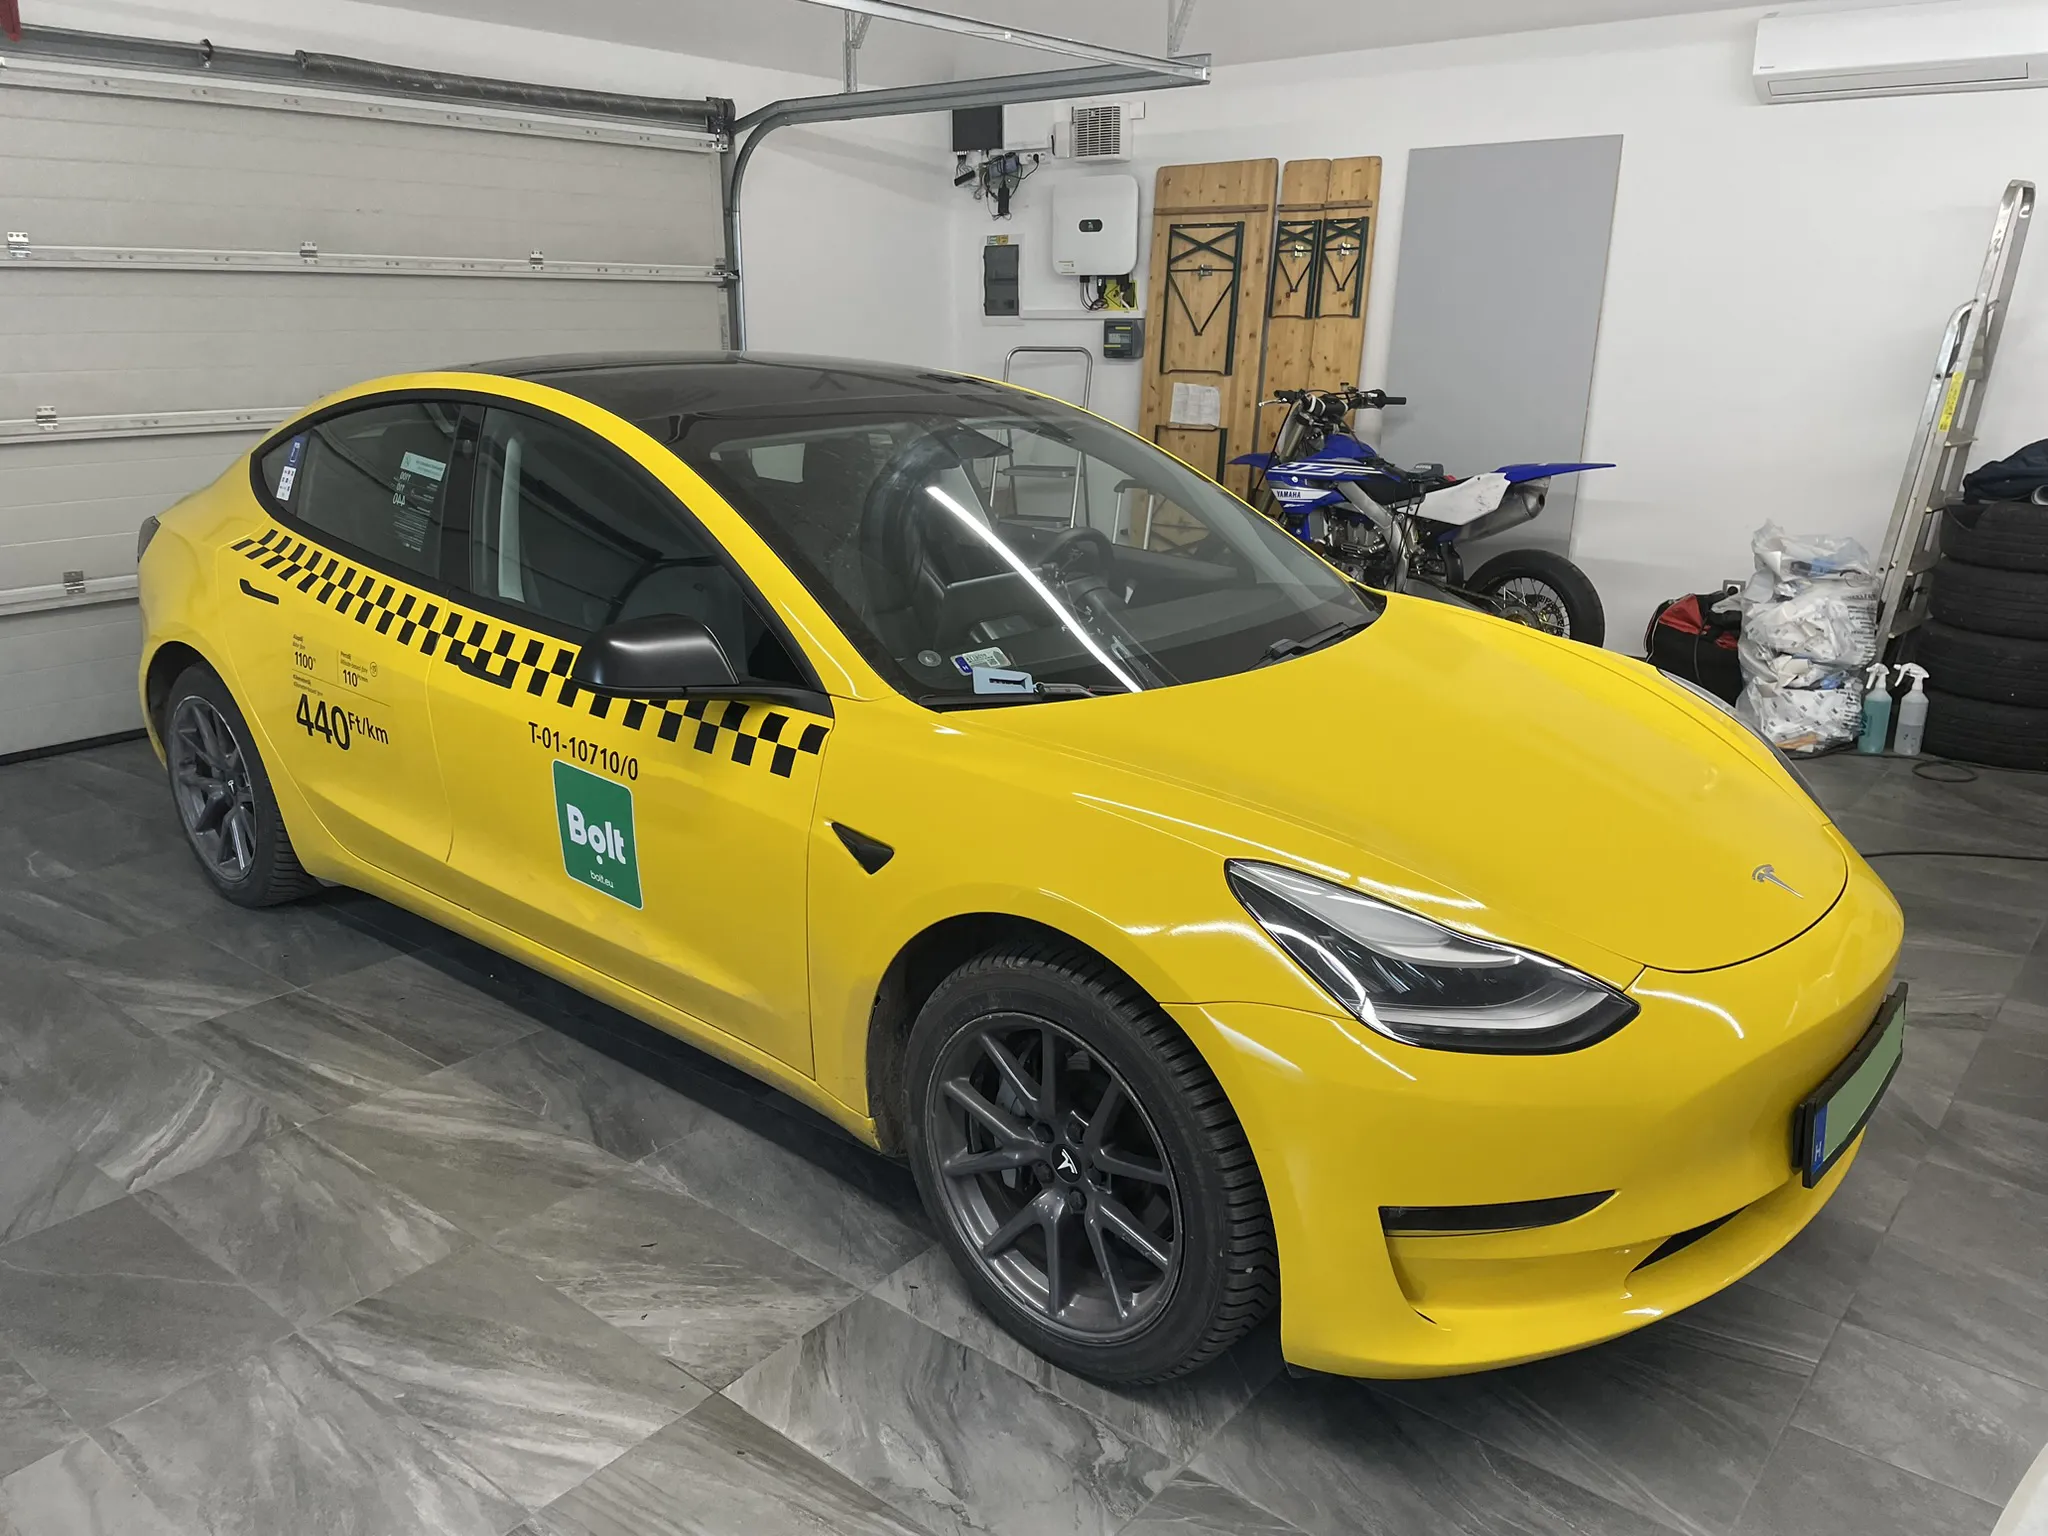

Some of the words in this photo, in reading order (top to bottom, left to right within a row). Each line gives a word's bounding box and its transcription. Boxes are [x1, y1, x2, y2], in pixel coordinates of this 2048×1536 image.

[1277, 490, 1301, 499] YAMAHA
[295, 651, 314, 670] 1100
[343, 669, 358, 687] 110
[296, 693, 350, 751] 440
[348, 711, 389, 745] Ft/km
[528, 721, 639, 780] T-01-10710/0
[566, 803, 626, 865] Bolt
[590, 870, 614, 888] bolt.eu
[1814, 1141, 1823, 1162] H
